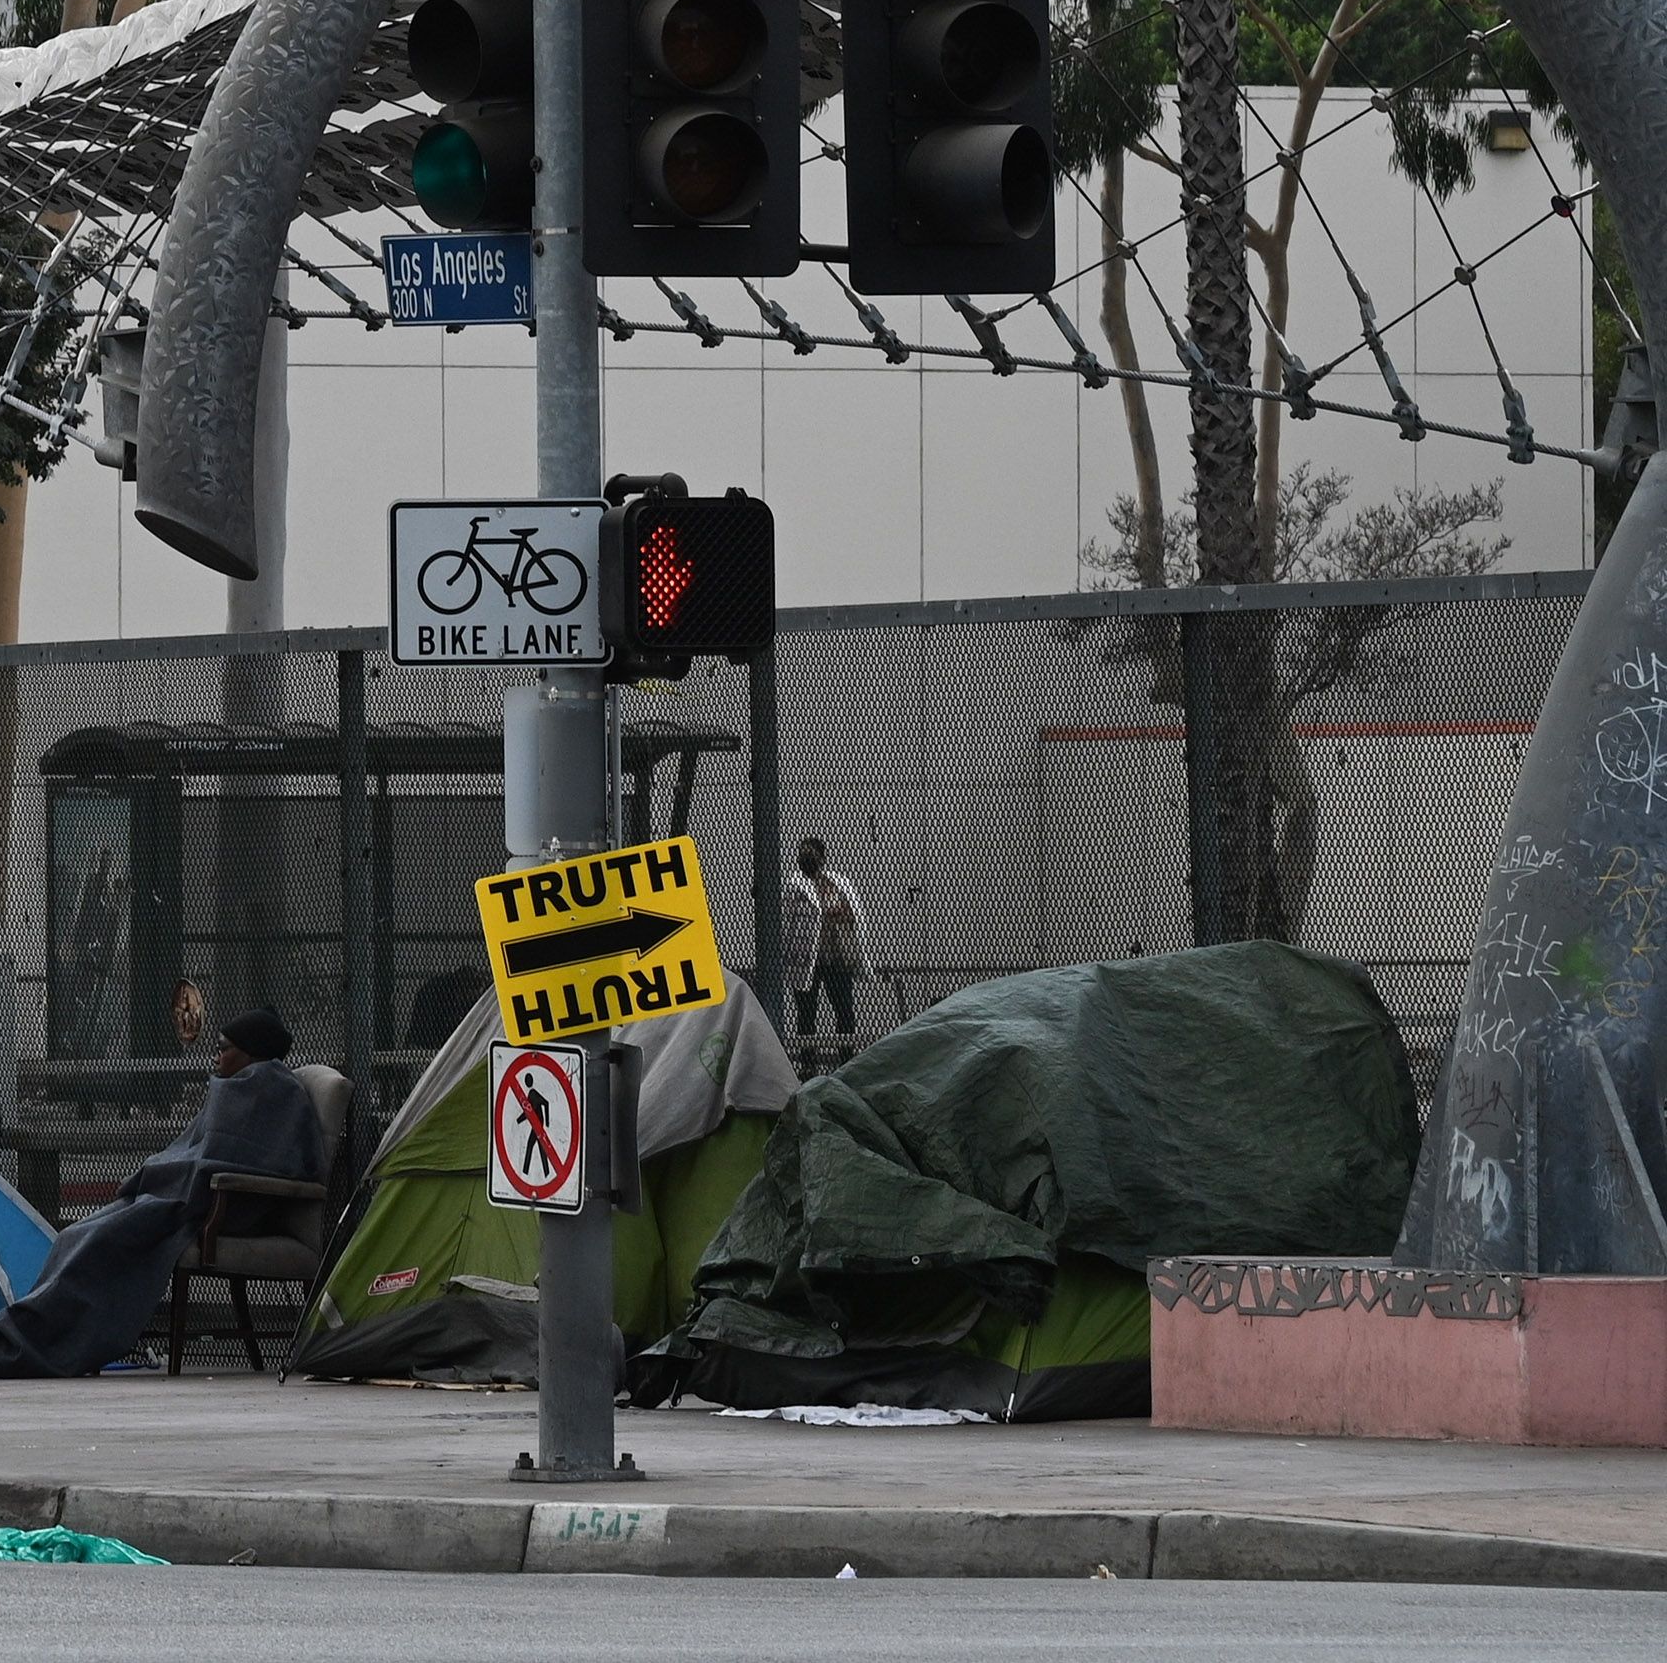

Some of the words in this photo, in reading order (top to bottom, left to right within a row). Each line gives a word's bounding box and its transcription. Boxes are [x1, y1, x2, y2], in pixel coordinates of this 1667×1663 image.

[388, 243, 423, 287] Los
[432, 241, 506, 300] Angeles
[392, 288, 418, 319] 300
[423, 287, 433, 318] N
[513, 285, 528, 315] St
[418, 625, 487, 656] BIKE
[503, 624, 582, 655] LANE
[489, 844, 688, 924] TRUTH
[512, 959, 712, 1038] TRUTH
[372, 1271, 415, 1291] Coleman
[556, 1510, 641, 1543] J-547
